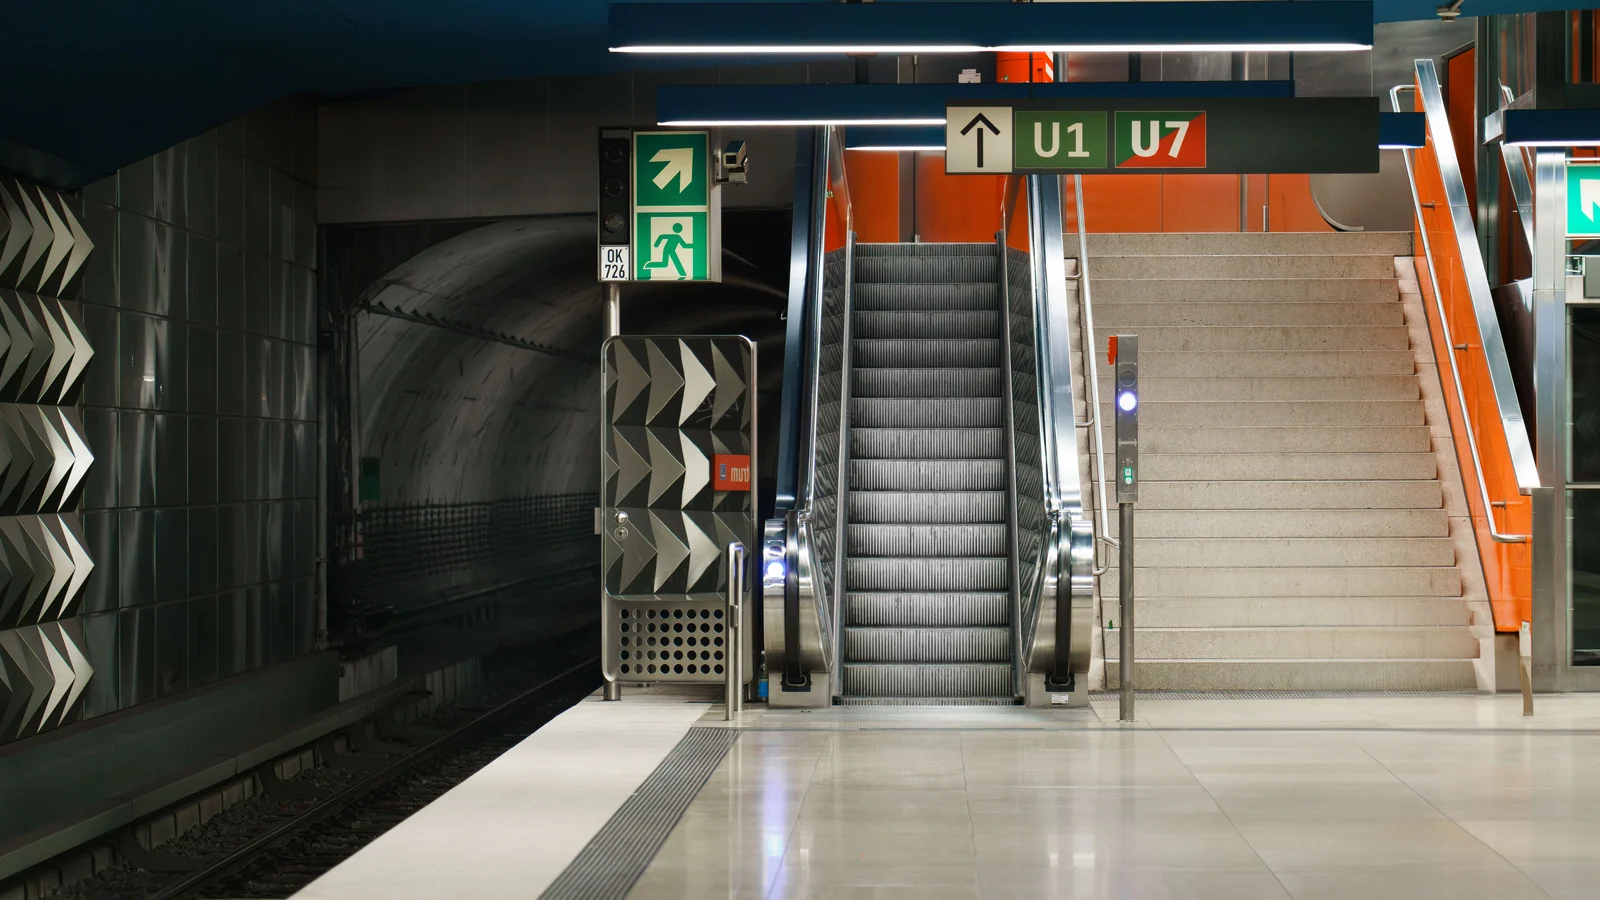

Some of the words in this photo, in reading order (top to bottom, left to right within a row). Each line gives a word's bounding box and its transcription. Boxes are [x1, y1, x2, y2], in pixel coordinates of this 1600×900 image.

[1034, 122, 1090, 158] U1
[1131, 120, 1190, 159] U7
[607, 249, 623, 263] OK
[605, 264, 625, 279] 726
